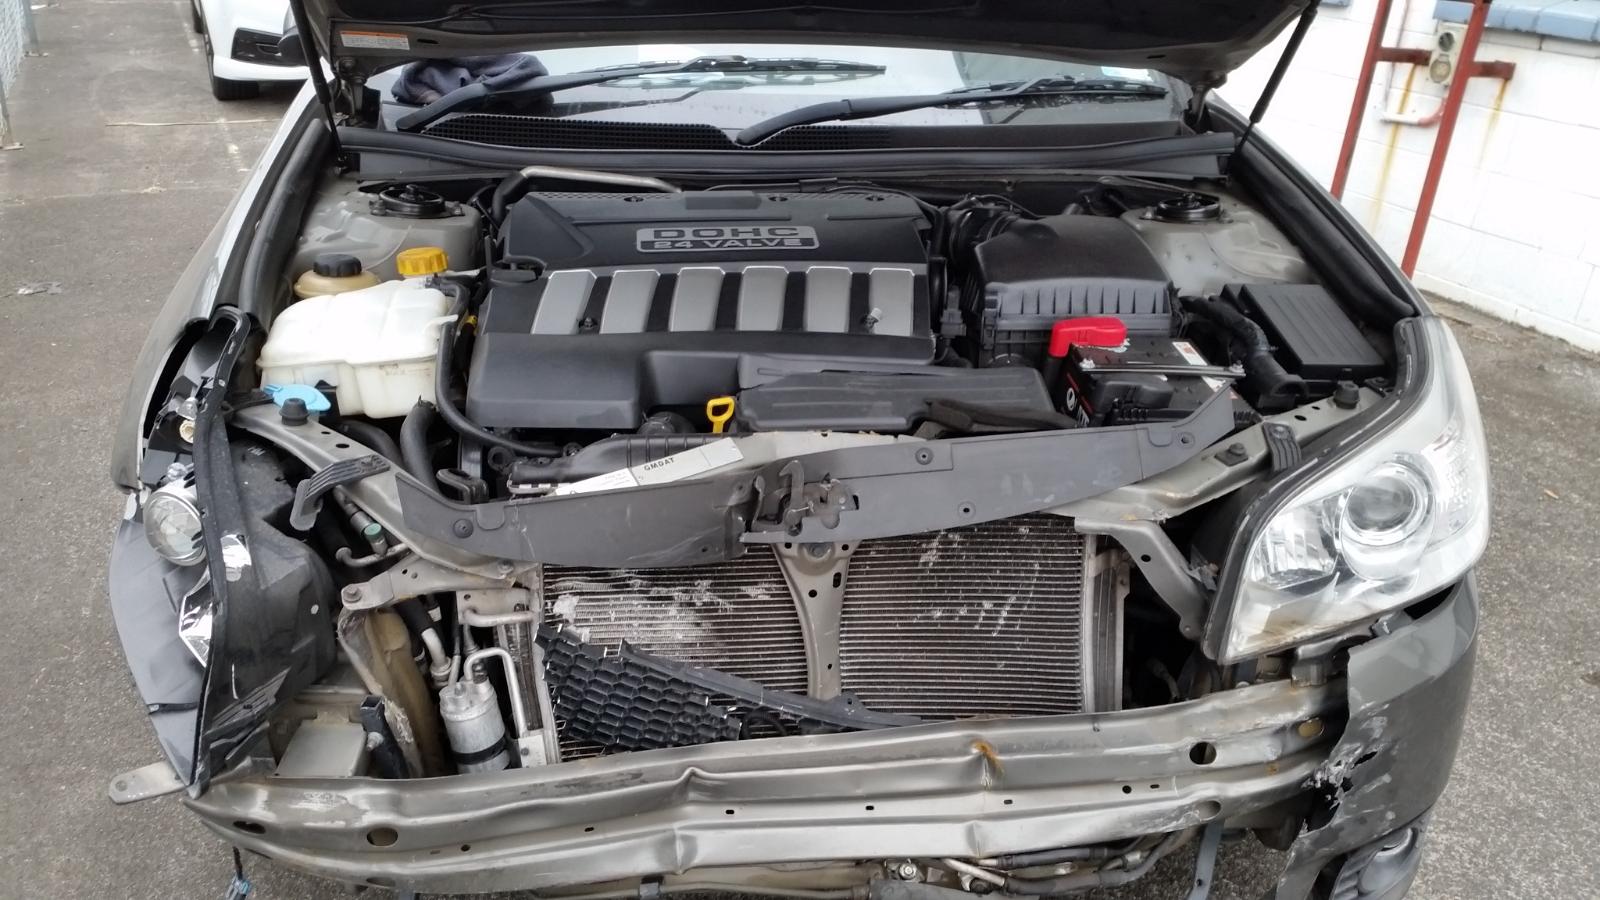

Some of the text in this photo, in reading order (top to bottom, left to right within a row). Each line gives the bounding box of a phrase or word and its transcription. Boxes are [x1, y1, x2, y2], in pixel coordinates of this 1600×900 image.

[653, 228, 800, 239] DOHC
[654, 238, 803, 249] 24 VALVE
[644, 457, 675, 470] GMDAT
